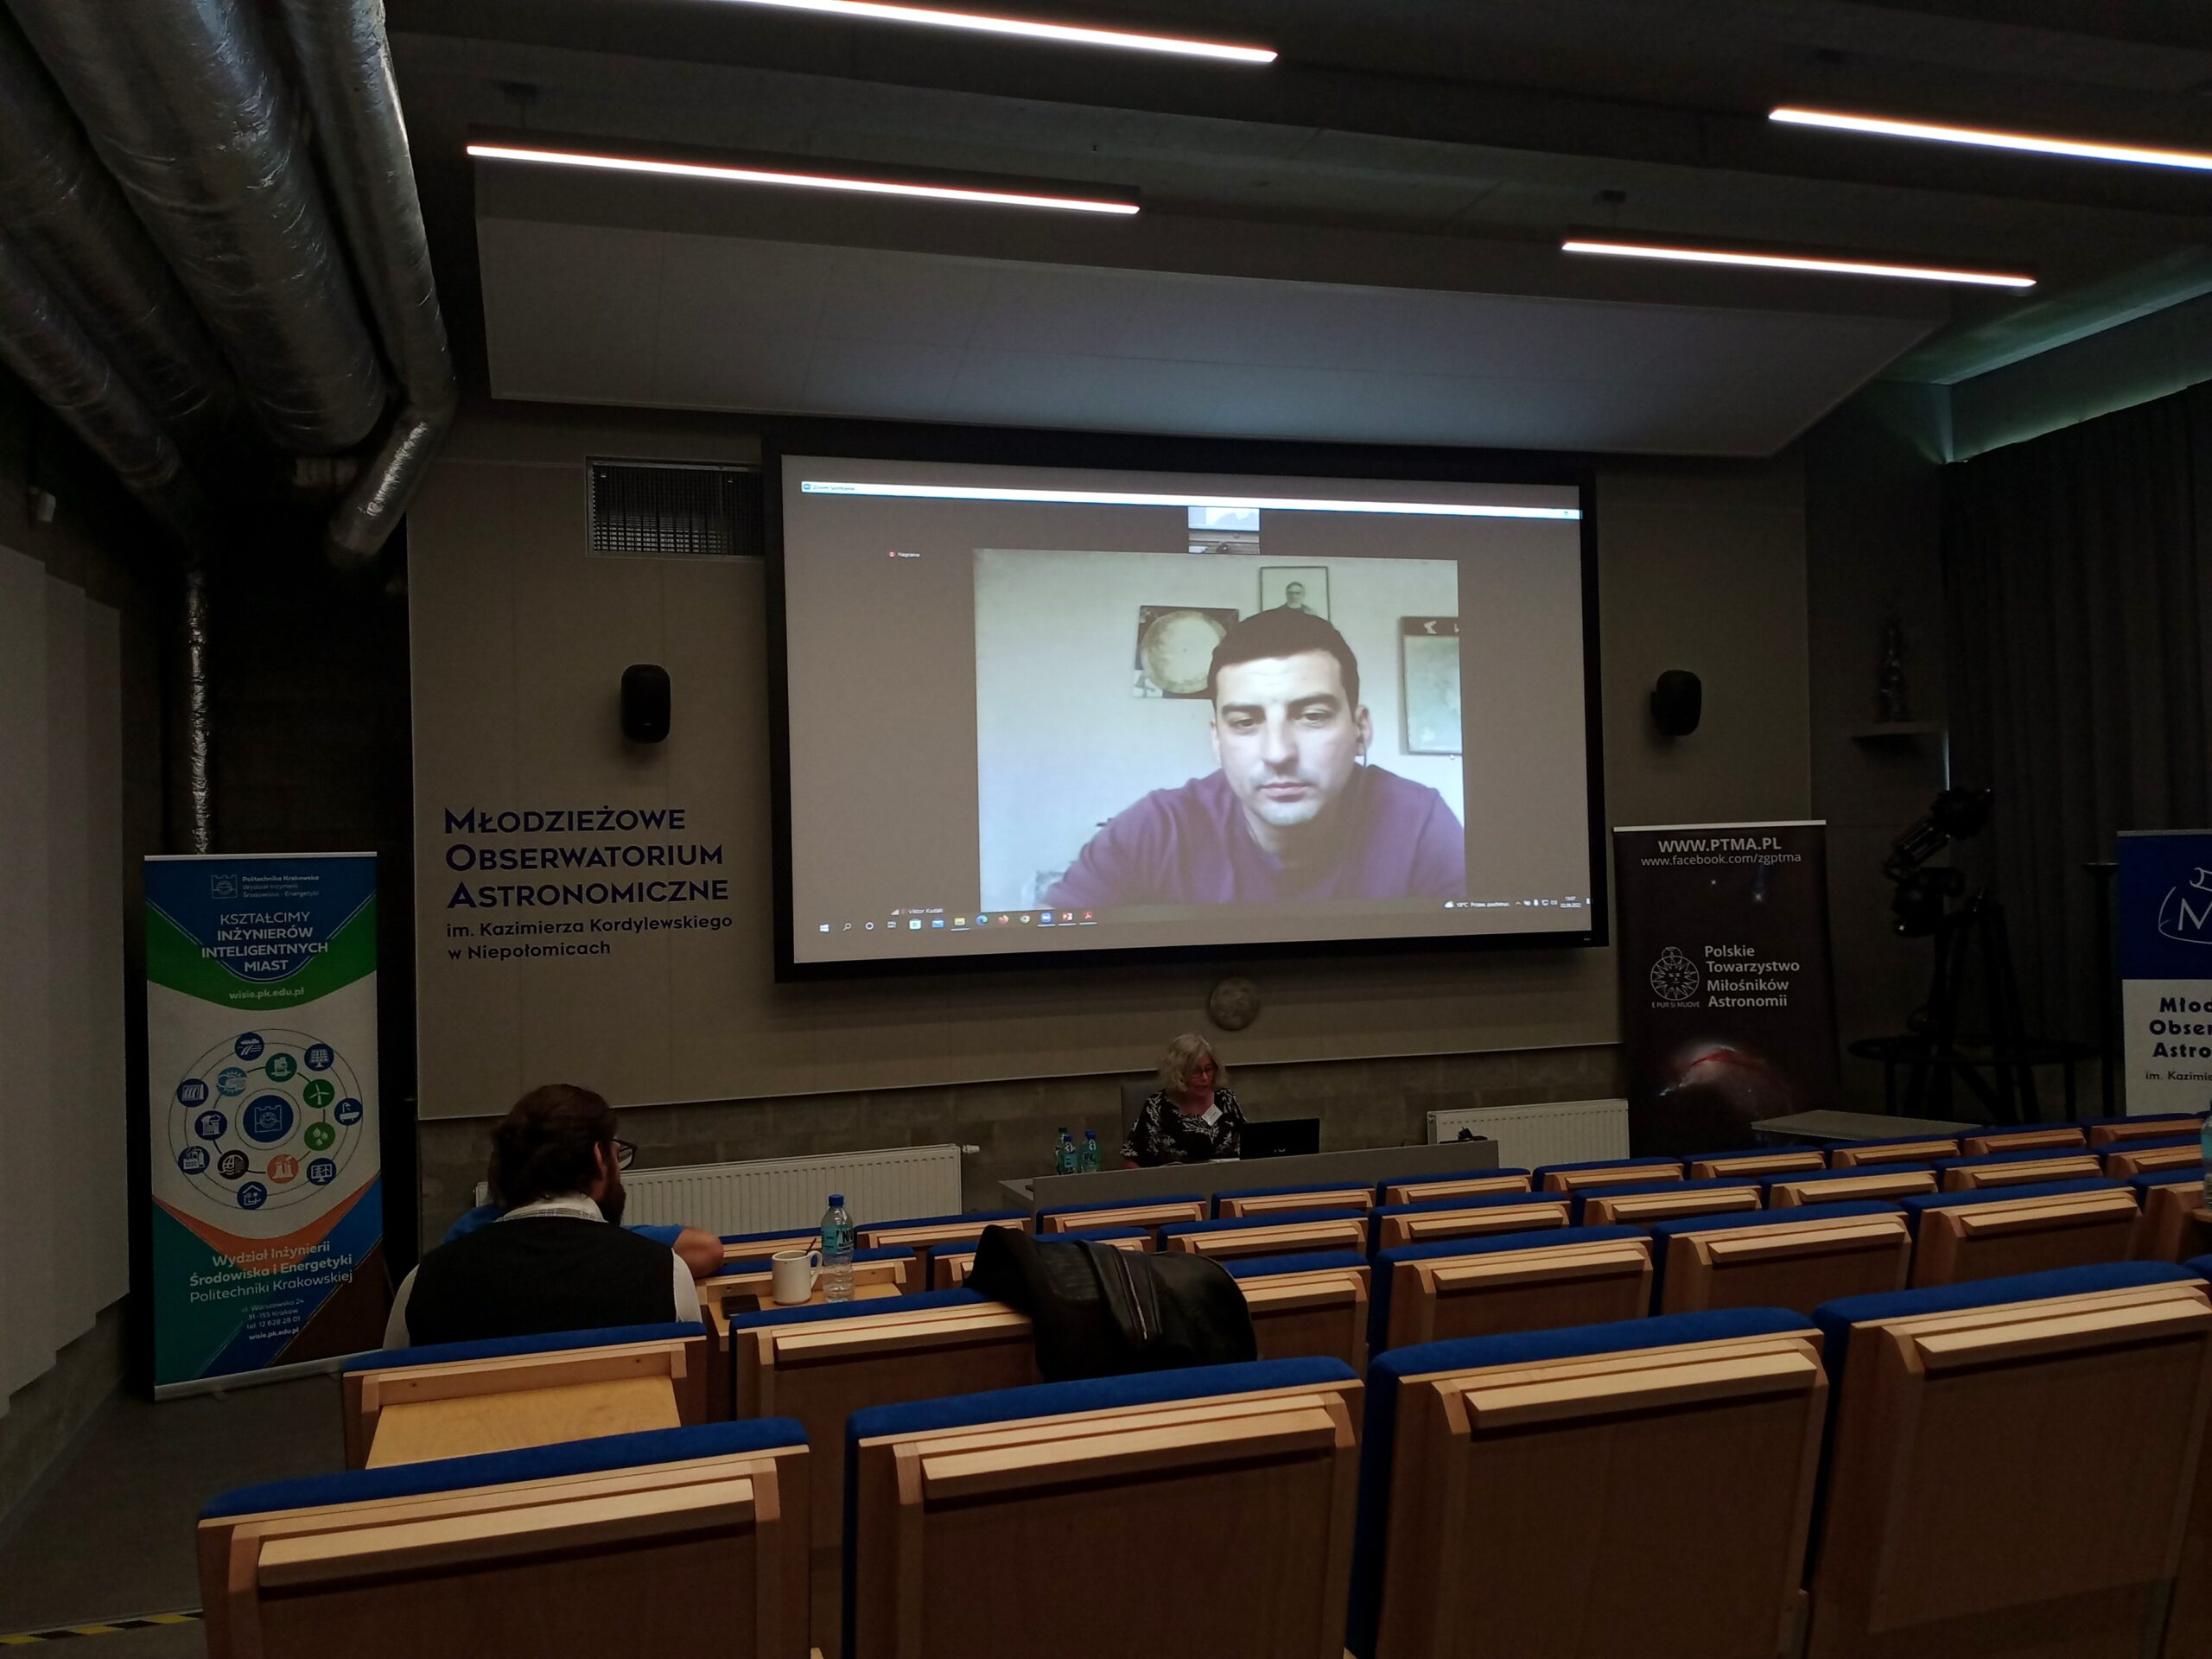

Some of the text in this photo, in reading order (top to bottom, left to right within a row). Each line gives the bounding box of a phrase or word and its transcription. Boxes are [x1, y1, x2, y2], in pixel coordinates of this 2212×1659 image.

[445, 805, 685, 834] MŁODZIEŻOWE
[1658, 837, 1782, 853] WWW.PTMA.PL
[446, 843, 722, 871] OBSERWATORIUM
[1641, 853, 1802, 867] www.facebook.com/zgptma
[447, 880, 729, 908] ASTRONOMICZNE
[220, 912, 310, 925] KSZTAŁCIMY
[447, 914, 733, 938] im. Kazimierza Kordylewskiego
[217, 925, 314, 941] INŻYNIERÓW
[201, 943, 328, 958] INTELIGENTNYCH
[448, 941, 611, 961] w Niepołomicach
[1705, 945, 1755, 958] Polskie
[244, 960, 289, 972] MIAST
[1706, 961, 1800, 975] Towarzystwo
[1707, 978, 1789, 992] Miłośników
[1708, 995, 1788, 1007] Astronomii
[2152, 1042, 2212, 1058] Astro
[2145, 1071, 2163, 1080] im.
[212, 1241, 330, 1268] Wydział Inżynierii
[190, 1254, 353, 1287] Środowiska i Energetyki
[190, 1271, 353, 1303] Politechniki Krakowskiej
[271, 1308, 299, 1317] Kraków
